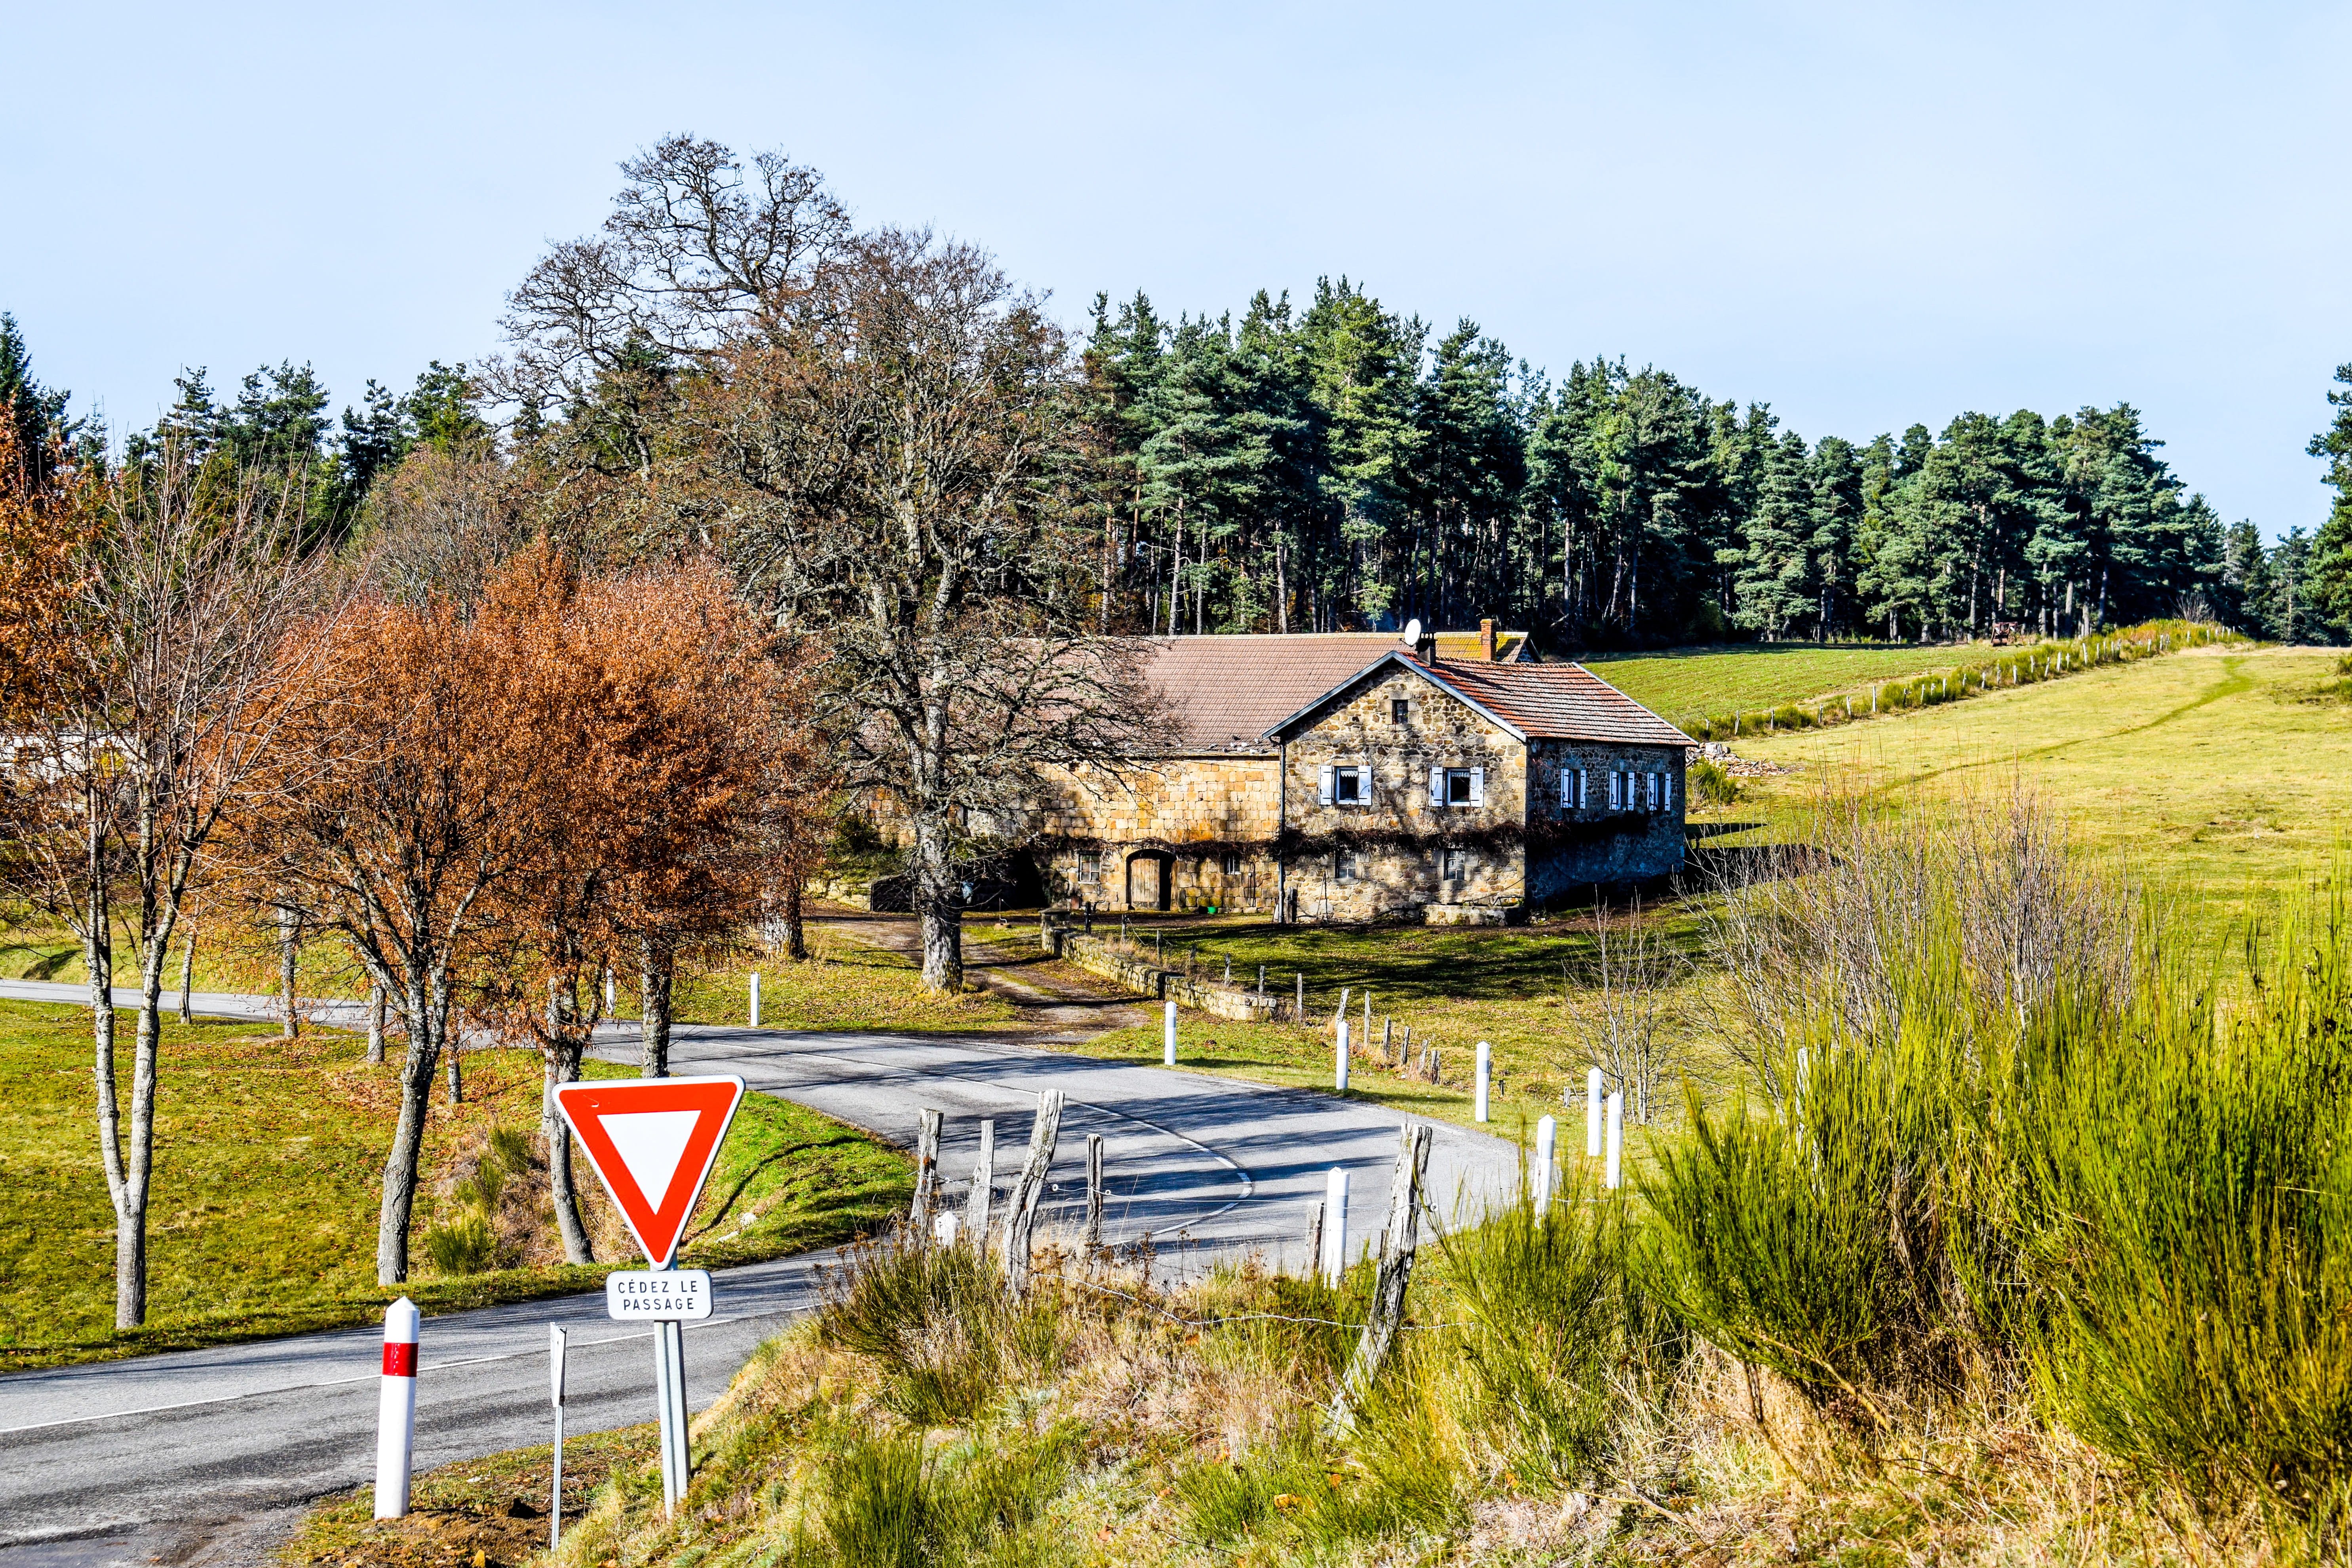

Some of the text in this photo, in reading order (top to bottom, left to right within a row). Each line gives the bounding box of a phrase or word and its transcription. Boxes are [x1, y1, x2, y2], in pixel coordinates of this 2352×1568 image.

[618, 1279, 698, 1293] CÉDEZ LE
[624, 1298, 694, 1310] PASSAGE
